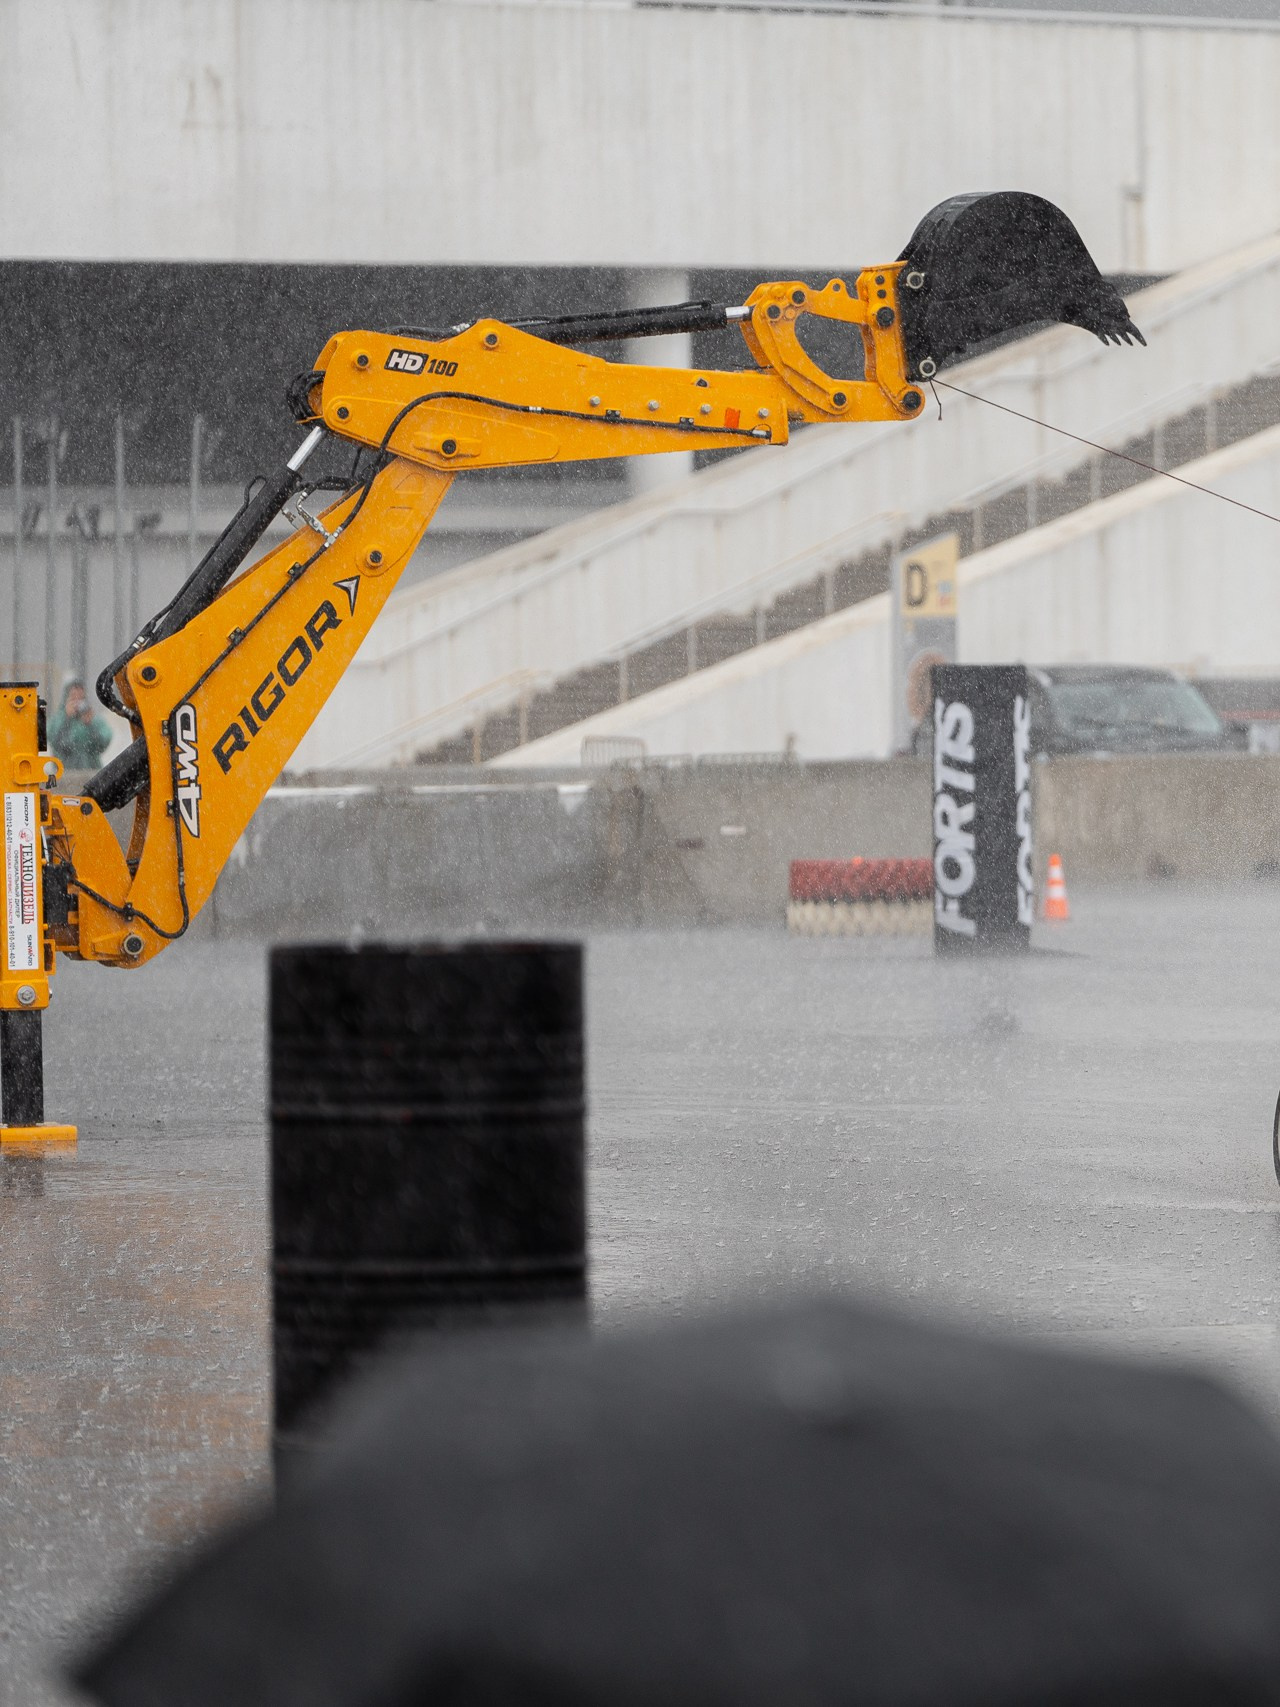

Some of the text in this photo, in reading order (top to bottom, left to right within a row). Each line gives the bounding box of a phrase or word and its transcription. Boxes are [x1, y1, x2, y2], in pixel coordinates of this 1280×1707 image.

[387, 351, 458, 377] HD 100
[211, 599, 343, 776] RIGOR
[175, 702, 201, 839] 4WD
[934, 697, 976, 937] FORTIS
[23, 843, 34, 924] ТЕХНОДИЗЕЛЬ
